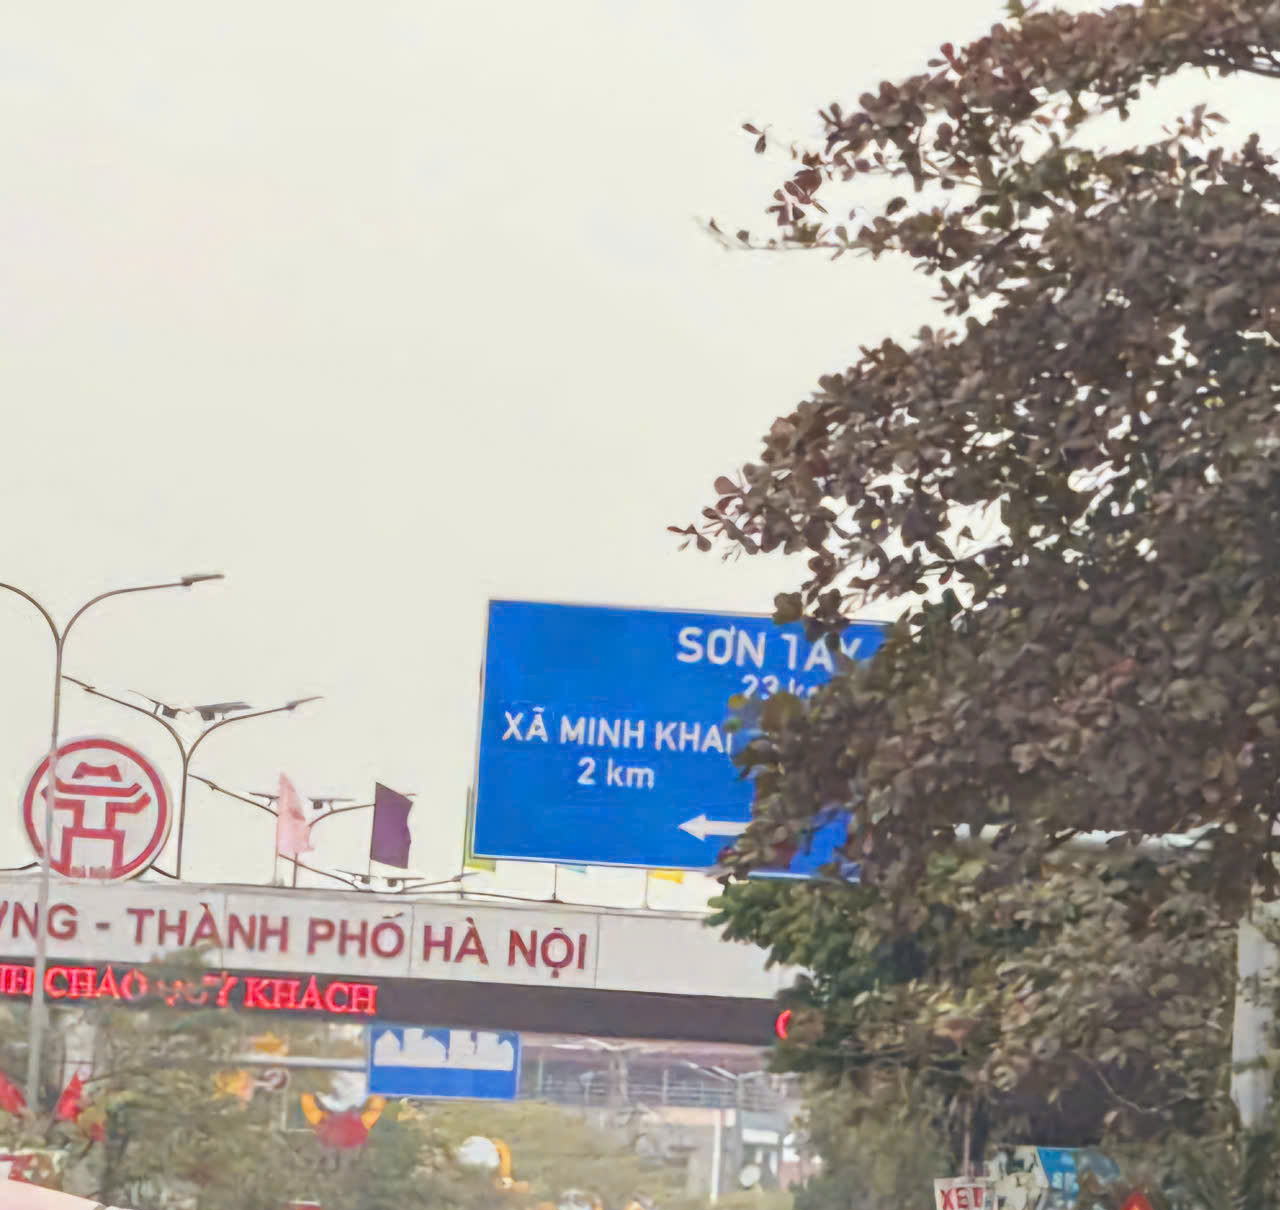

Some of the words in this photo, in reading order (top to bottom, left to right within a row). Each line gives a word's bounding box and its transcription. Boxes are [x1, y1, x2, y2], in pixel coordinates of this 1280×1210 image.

[676, 625, 767, 668] SƠN
[501, 706, 549, 743] XÃ
[559, 715, 646, 749] MINH
[577, 756, 597, 786] 2
[606, 760, 656, 790] km
[0, 902, 79, 942] NG
[127, 902, 289, 955] THÀNH
[306, 912, 405, 959] PHỐ
[422, 917, 489, 966] HÀ
[508, 926, 588, 979] NỘI
